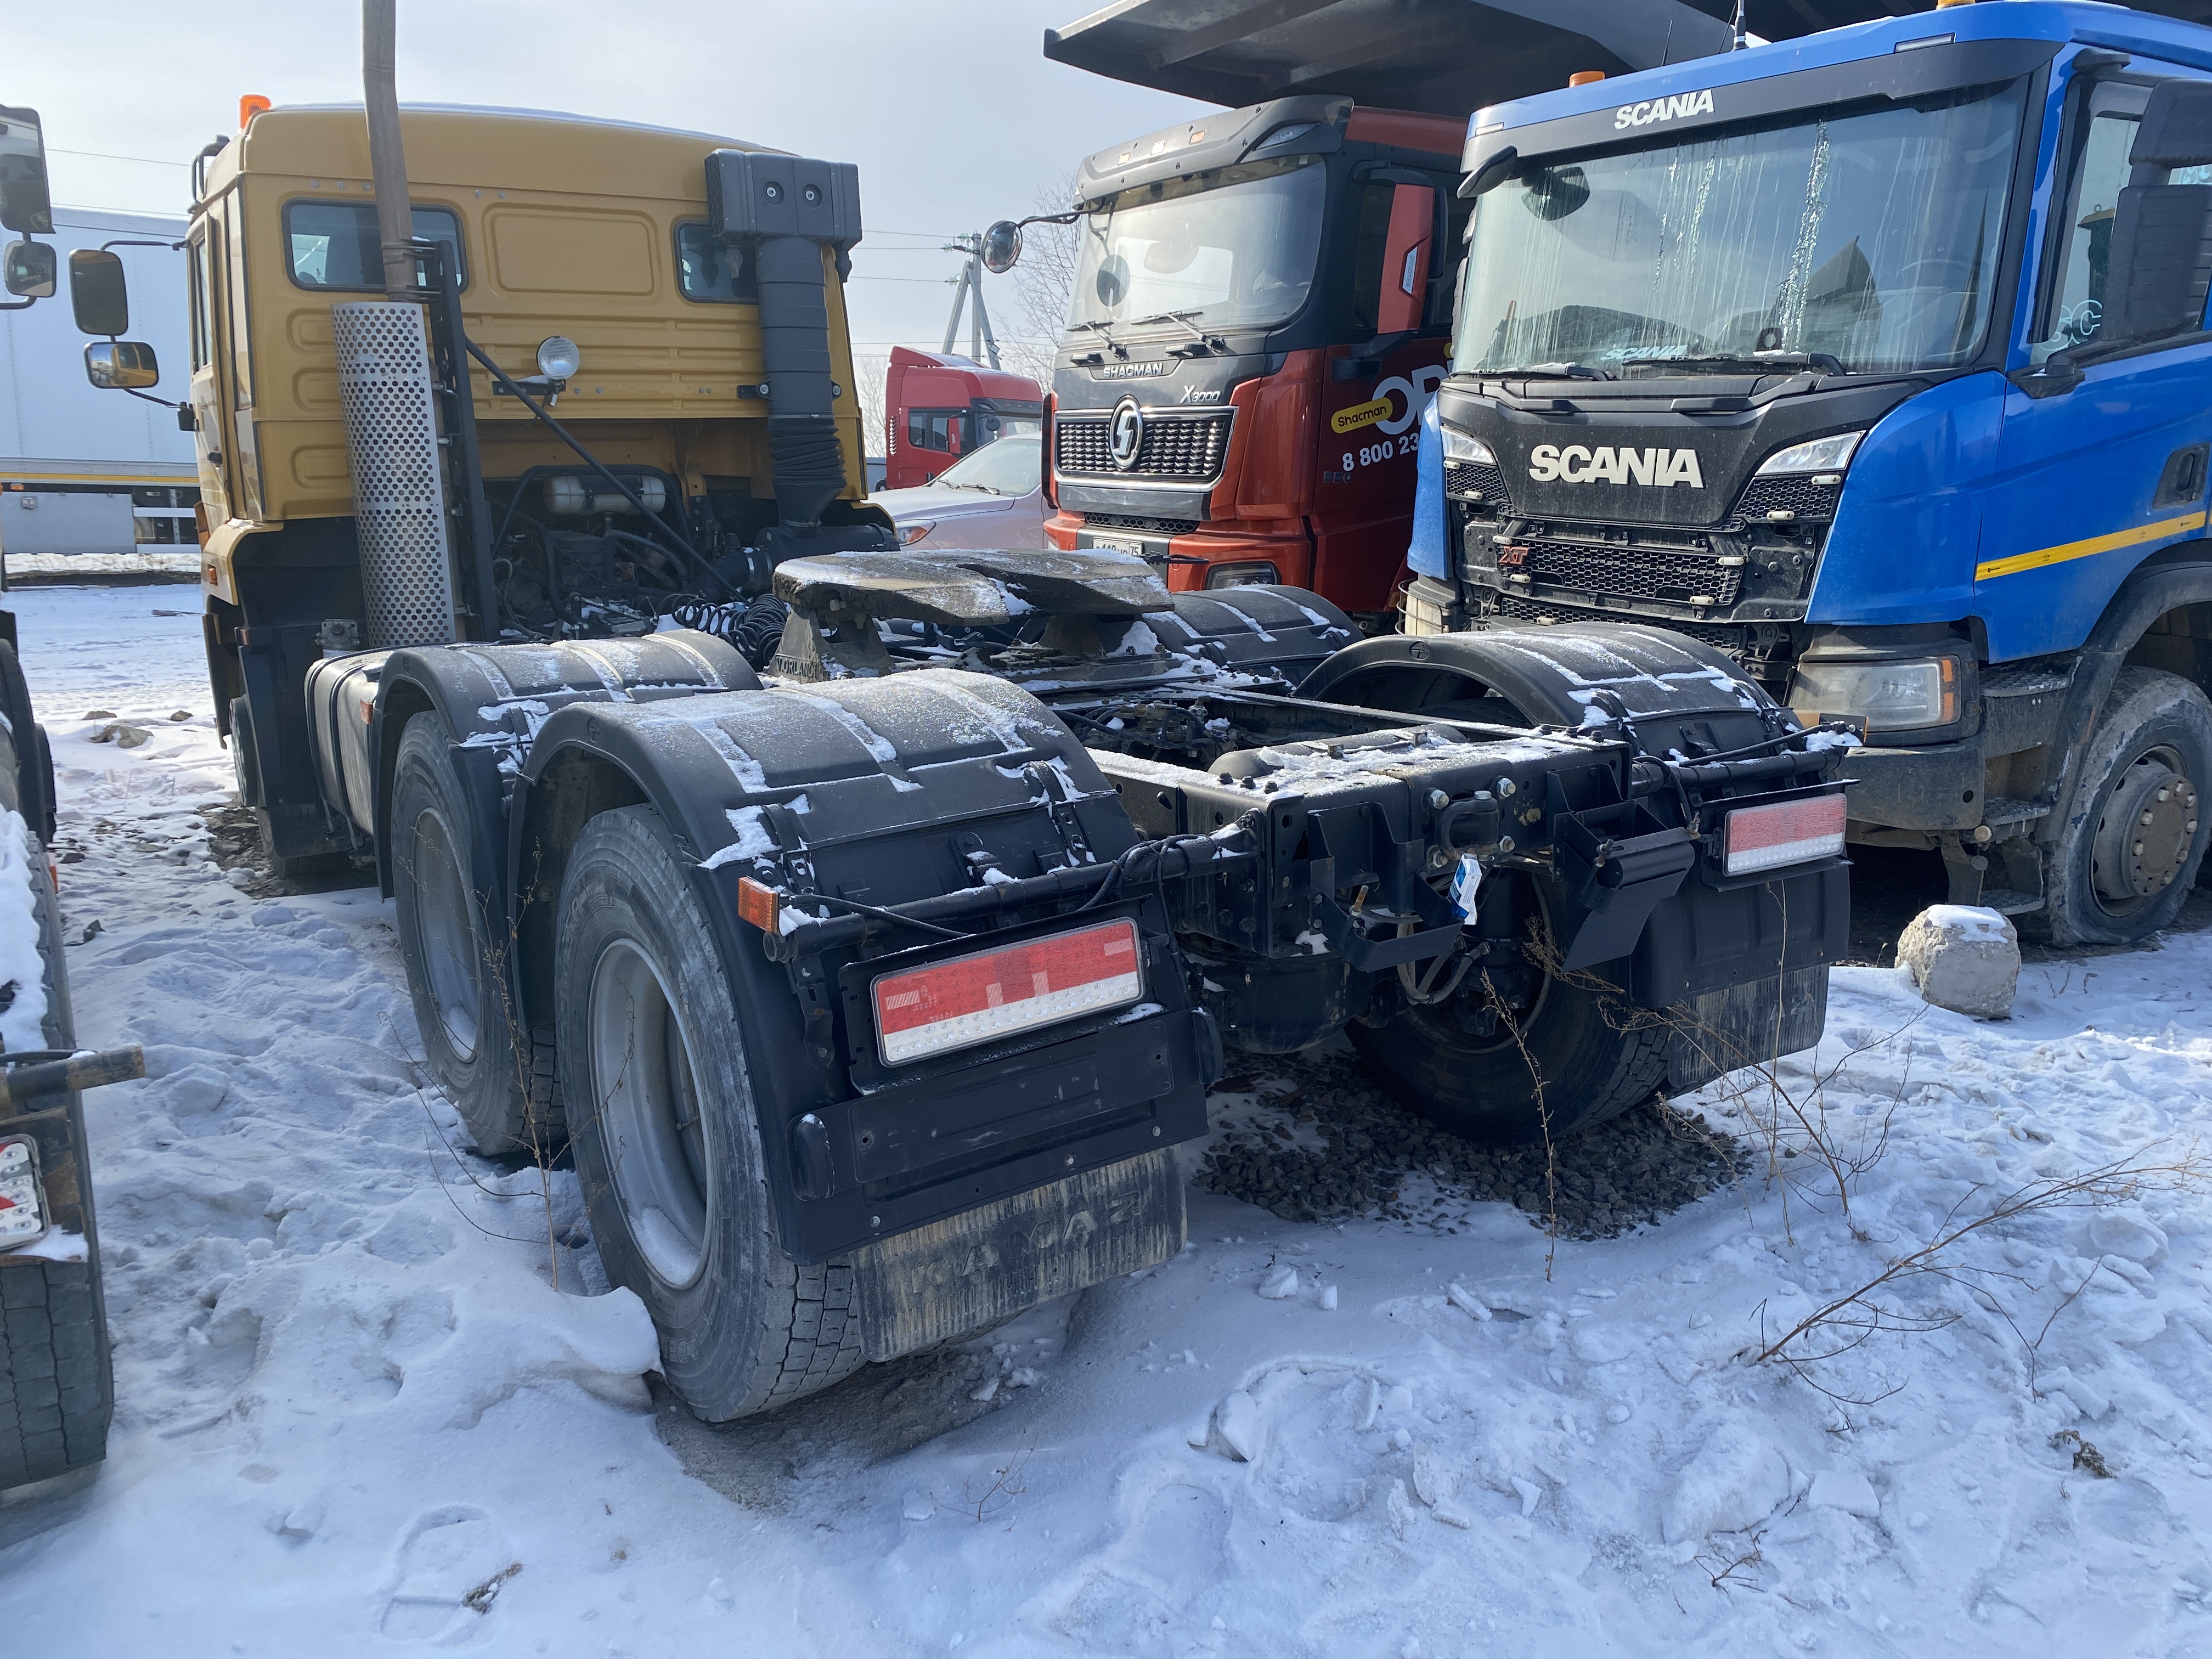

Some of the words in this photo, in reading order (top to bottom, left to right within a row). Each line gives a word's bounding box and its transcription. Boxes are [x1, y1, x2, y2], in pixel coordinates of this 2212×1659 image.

[1614, 89, 1714, 129] SCANIA
[1600, 345, 1688, 361] SCANIA
[1103, 362, 1163, 379] SHACMAN
[1180, 385, 1221, 404] X3000
[1338, 405, 1387, 427] Shacman
[1342, 453, 1355, 472] 8
[1359, 441, 1393, 466] 800
[1528, 444, 1705, 489] SCANIA
[1498, 546, 1530, 565] XT
[910, 1190, 1142, 1294] KAMAZ
